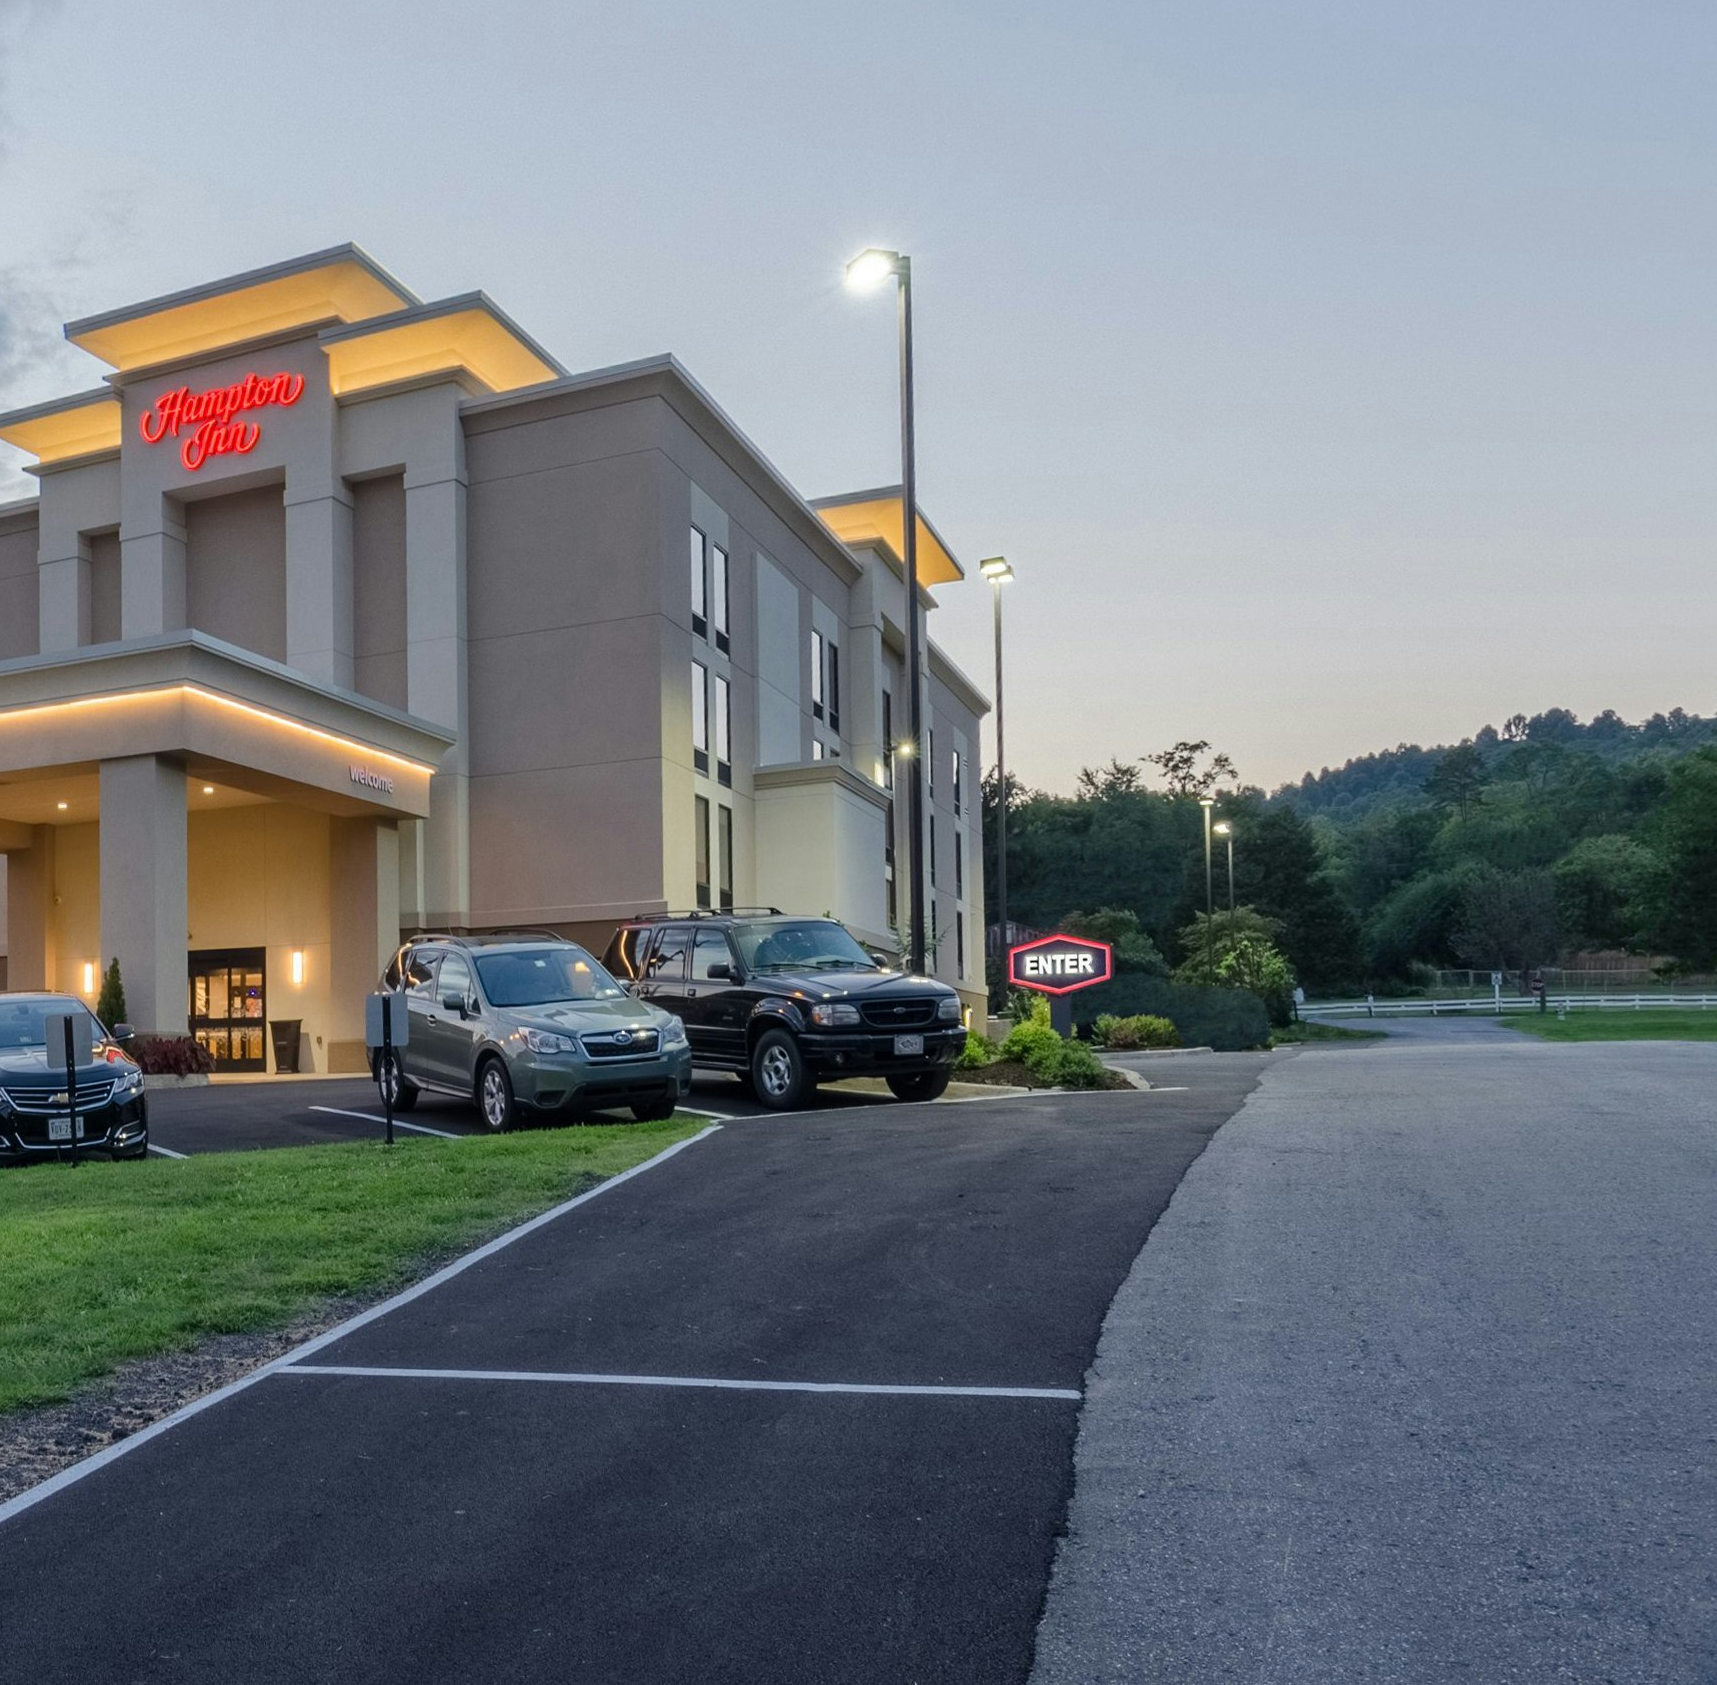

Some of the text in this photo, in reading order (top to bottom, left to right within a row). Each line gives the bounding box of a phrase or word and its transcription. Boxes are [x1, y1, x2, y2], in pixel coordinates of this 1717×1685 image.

[140, 372, 305, 443] Hampton
[181, 418, 261, 471] Inn
[348, 764, 394, 794] welcome
[1024, 953, 1095, 976] ENTER
